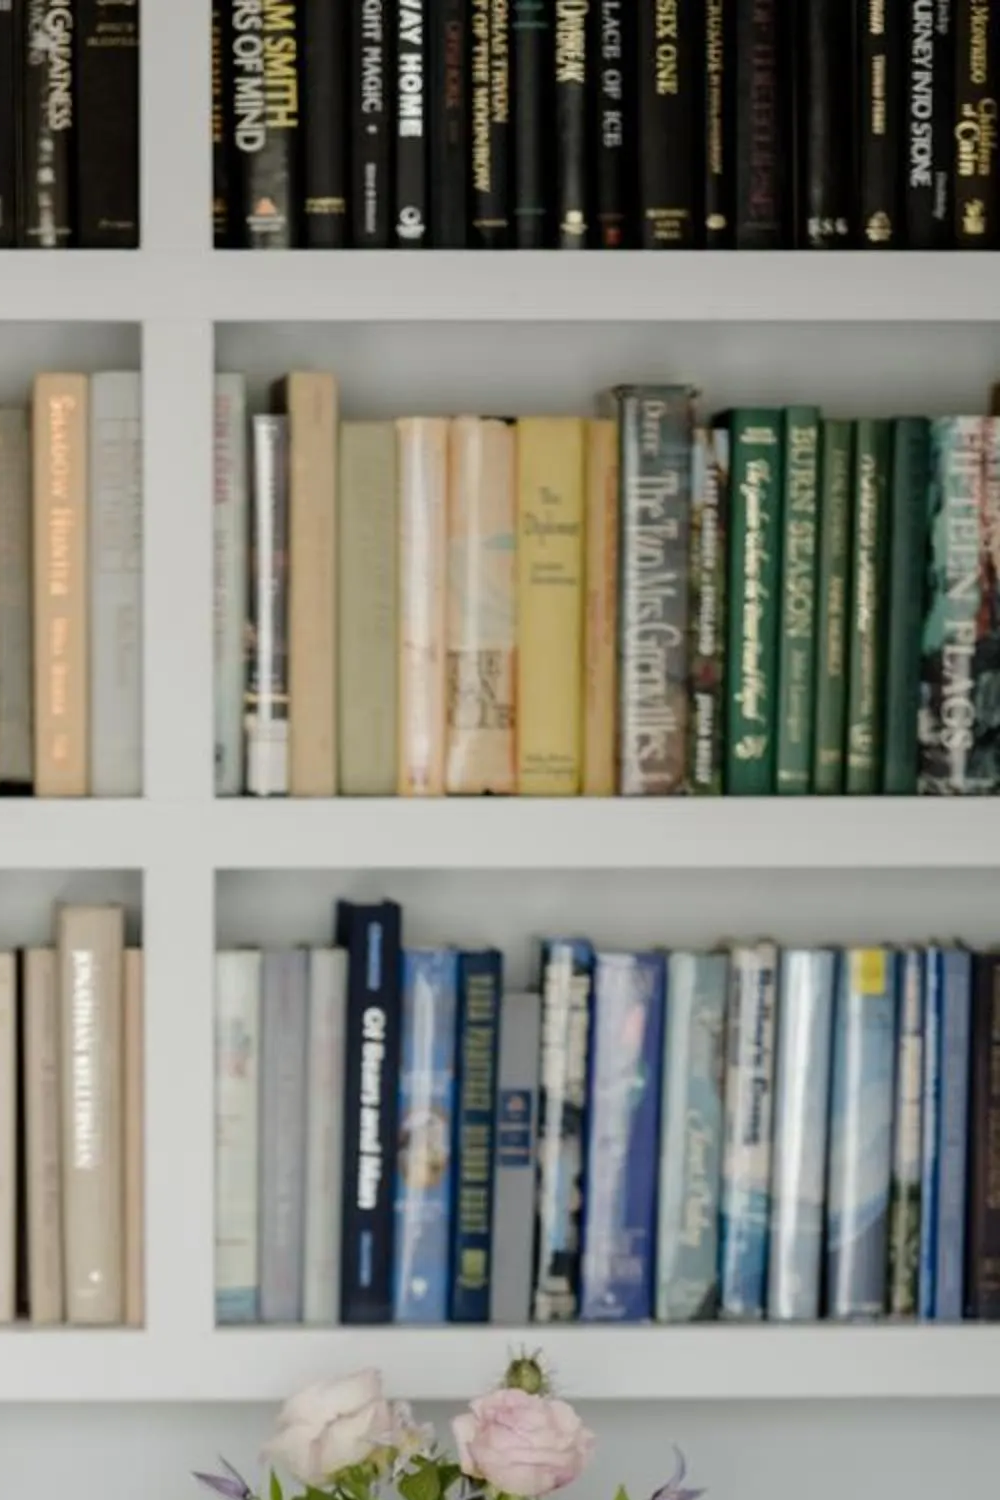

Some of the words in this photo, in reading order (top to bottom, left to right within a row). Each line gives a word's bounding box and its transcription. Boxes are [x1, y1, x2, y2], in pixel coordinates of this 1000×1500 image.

[361, 0, 383, 42] GHT
[601, 1, 622, 60] LACE
[910, 1, 934, 71] URNEY
[233, 34, 264, 72] OF
[361, 47, 384, 113] MAGIC
[472, 42, 490, 83] THE
[655, 43, 678, 96] ONE
[263, 36, 299, 128] SMITH
[399, 53, 424, 138] HOME
[601, 68, 622, 99] OF
[910, 71, 934, 121] INTO
[233, 77, 266, 153] MIND
[601, 110, 622, 148] ICE
[909, 122, 933, 189] STONE
[954, 120, 981, 176] Cain
[626, 470, 679, 518] The
[789, 427, 815, 514] BURN
[626, 518, 679, 570] Two
[786, 520, 814, 639] SEASON
[626, 621, 683, 762] Grenvilles
[940, 619, 977, 749] FLAGS
[362, 1007, 387, 1040] Of
[359, 1107, 382, 1153] and
